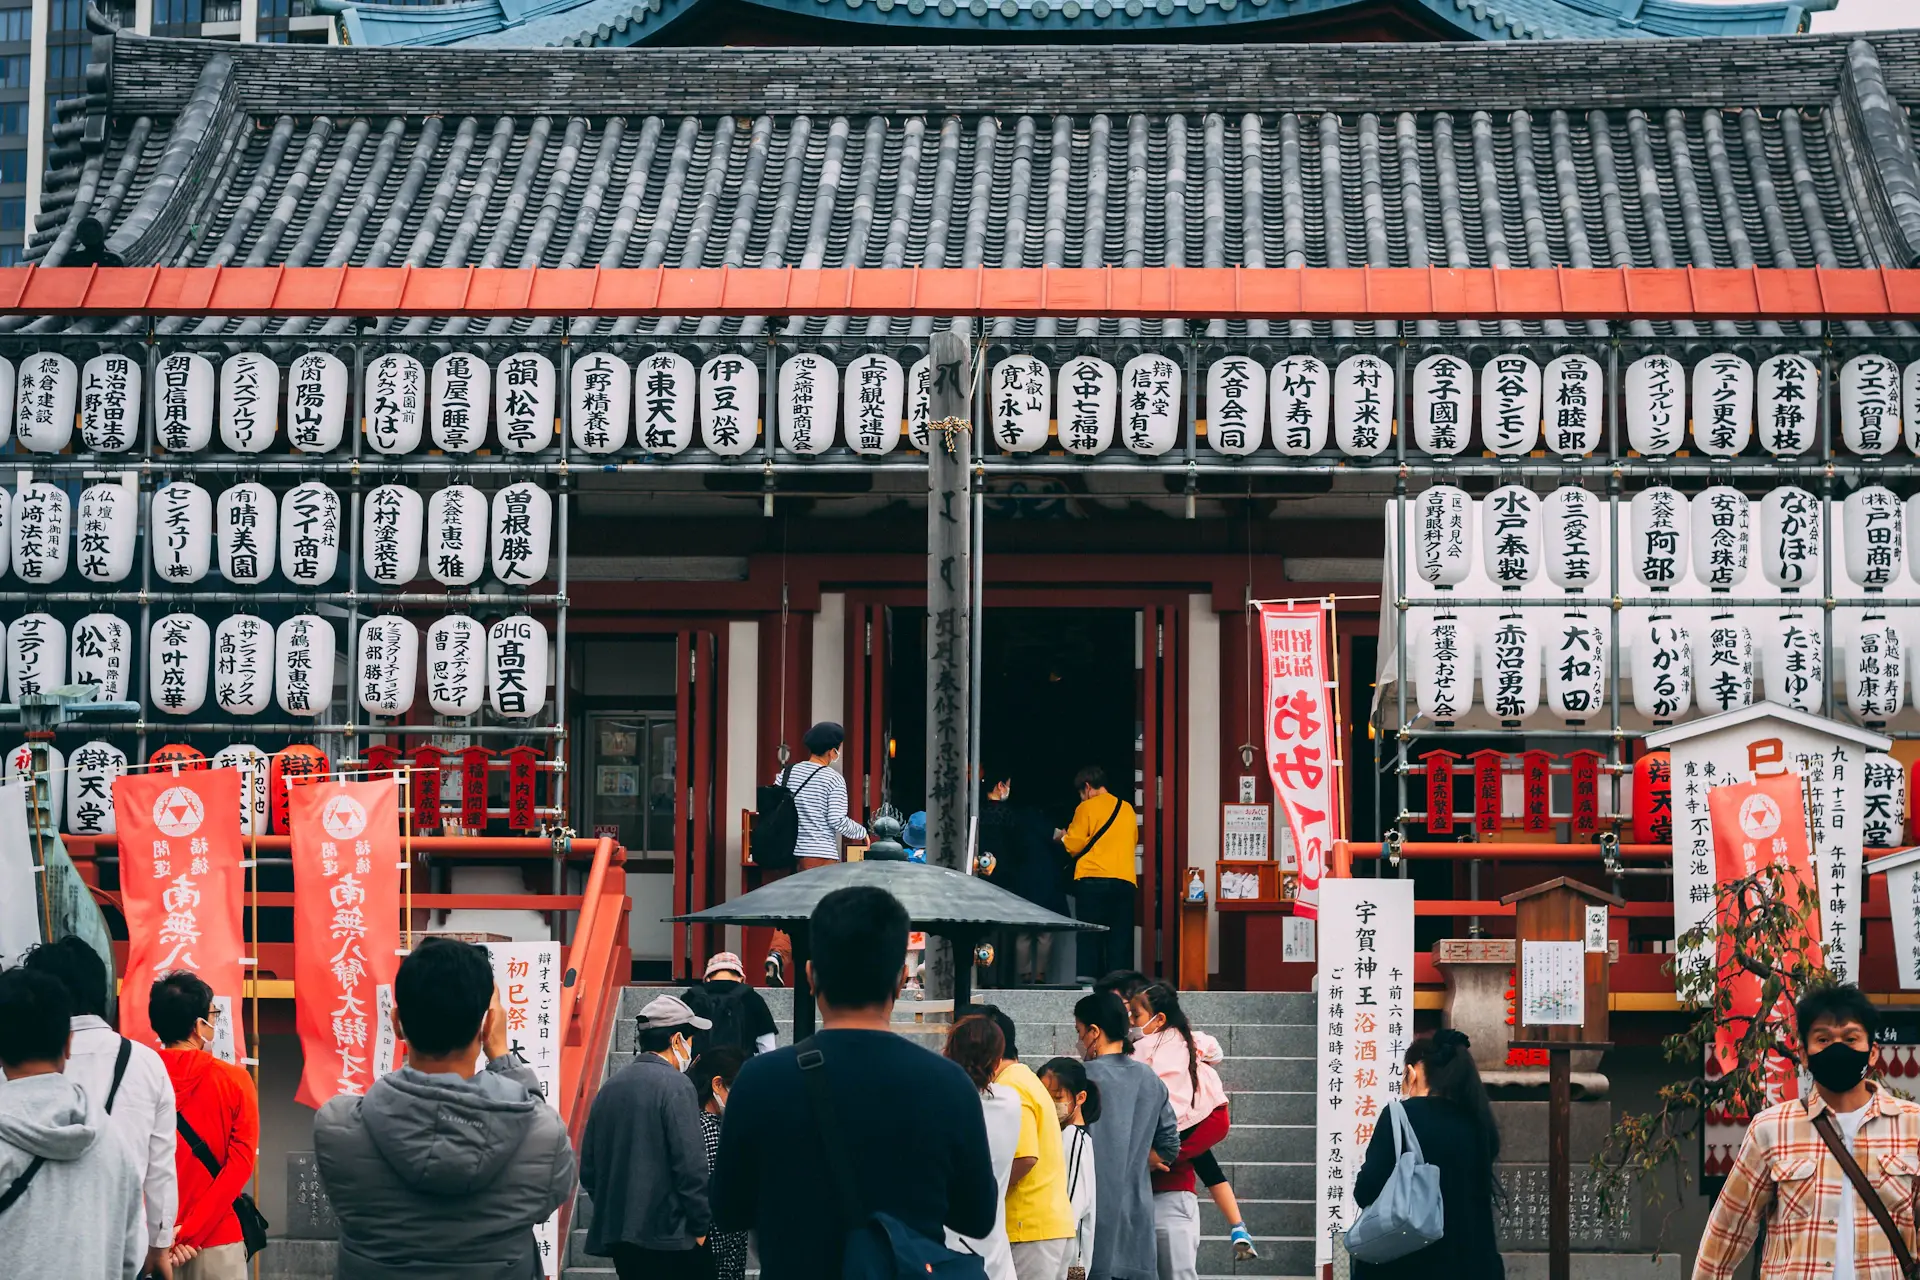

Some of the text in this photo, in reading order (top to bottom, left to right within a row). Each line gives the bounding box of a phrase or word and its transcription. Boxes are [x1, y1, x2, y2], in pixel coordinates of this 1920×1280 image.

[18, 373, 36, 438] 株式会社
[101, 358, 128, 450] 明治安田生命
[162, 355, 192, 449] 朝日信用金庫
[294, 355, 327, 447] 焼肉陽山道
[373, 356, 401, 449] あんみつみはし
[401, 359, 418, 425] 上野公園前
[504, 358, 539, 449] 韻松亭
[582, 357, 614, 448] 上野精養軒
[645, 356, 677, 449] (株)東天紅
[791, 357, 816, 451] 池之端仲町商店会
[858, 357, 888, 450] 上野観光連盟
[1025, 361, 1044, 412] 東叡山
[1069, 361, 1104, 450] 谷中七福神
[1129, 368, 1154, 449] 信者有志
[1219, 361, 1250, 449] 天音会一同
[1282, 374, 1316, 449] 竹寿司
[1428, 358, 1462, 449] 金子國義
[1496, 359, 1528, 449] 四谷シモン
[1556, 358, 1588, 449] 高橋睦郎
[1710, 359, 1742, 449] デューク更家
[1772, 358, 1806, 450] 松本静枝
[1857, 360, 1884, 450] ウエニ貿易
[293, 489, 321, 579] クマイ商店
[320, 490, 337, 547] 株式会社
[373, 488, 403, 580] 松村塗装店
[1424, 491, 1446, 581] 吉野眼科クリニック
[1710, 493, 1736, 584] 安田念珠店
[1780, 491, 1807, 583] なかほり
[493, 623, 531, 639] BHG
[1559, 625, 1592, 712] 大和田
[1651, 626, 1681, 717] いかるが
[514, 763, 531, 826] 家内安全
[1530, 767, 1545, 829] 身体健全
[1831, 745, 1848, 829] 九月十三日
